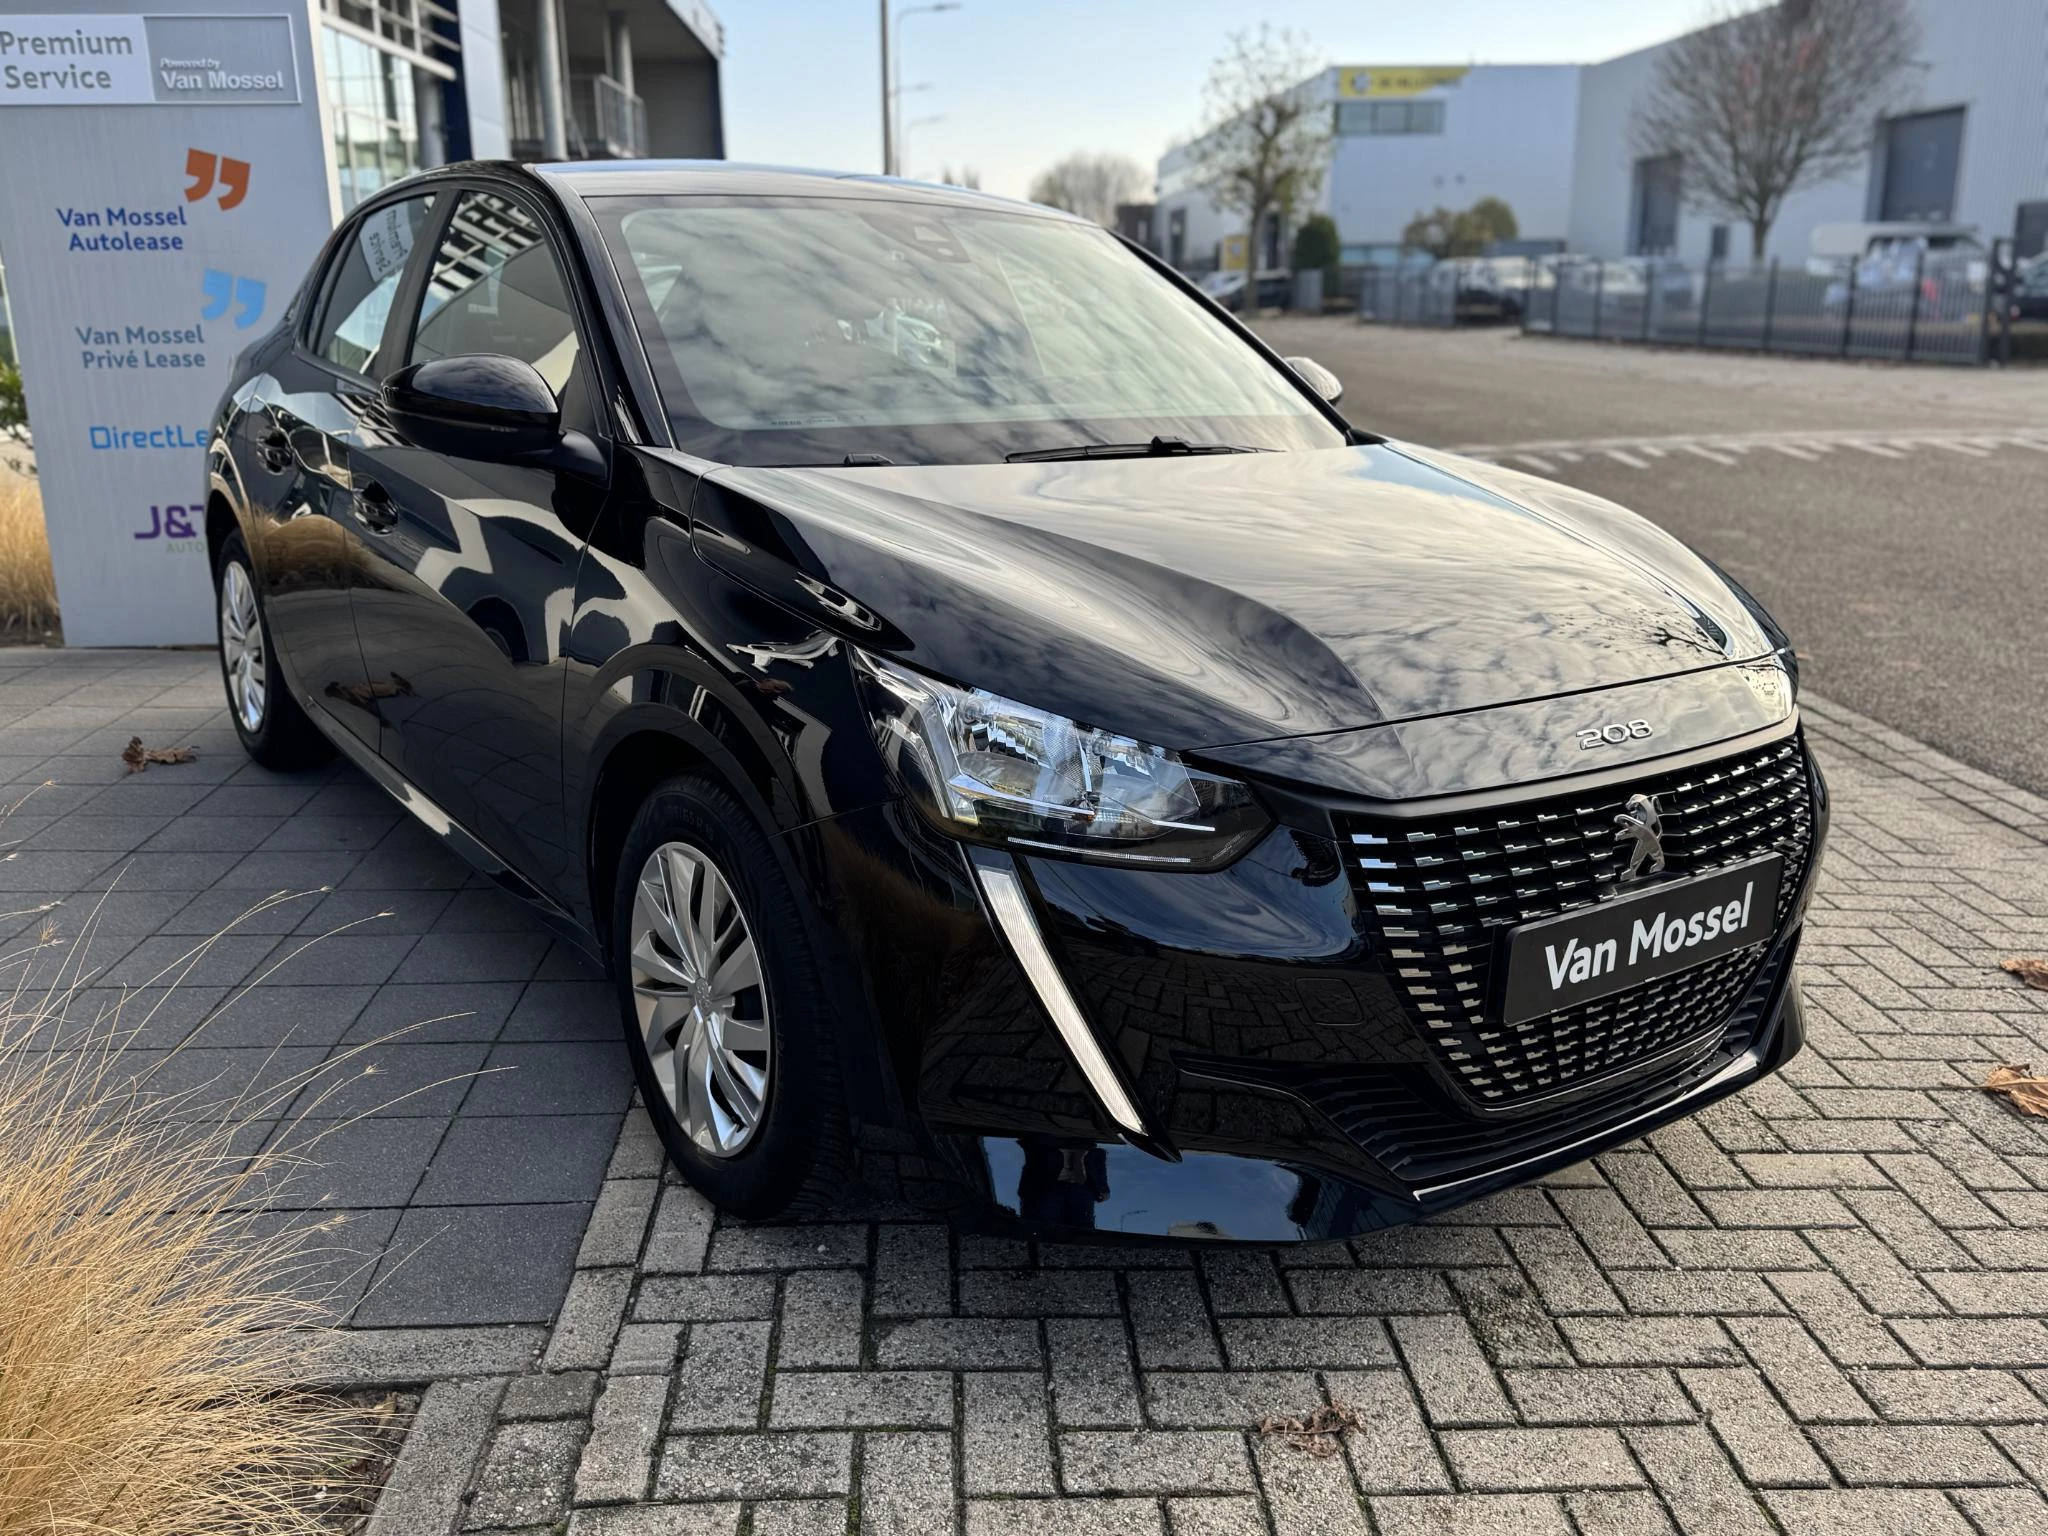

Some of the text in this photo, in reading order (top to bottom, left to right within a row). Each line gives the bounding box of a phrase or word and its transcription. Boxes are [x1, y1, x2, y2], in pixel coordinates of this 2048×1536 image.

[0, 30, 132, 55] Premium
[160, 57, 221, 70] Powered by
[4, 64, 112, 89] Service
[161, 70, 284, 89] Van Mossel
[57, 206, 187, 227] Van Mossel
[69, 232, 184, 251] Autolease
[75, 324, 205, 346] Van Mossel
[82, 350, 206, 369] Privé Lease
[1576, 719, 1653, 750] 208
[1545, 881, 1753, 990] Van Mossel
